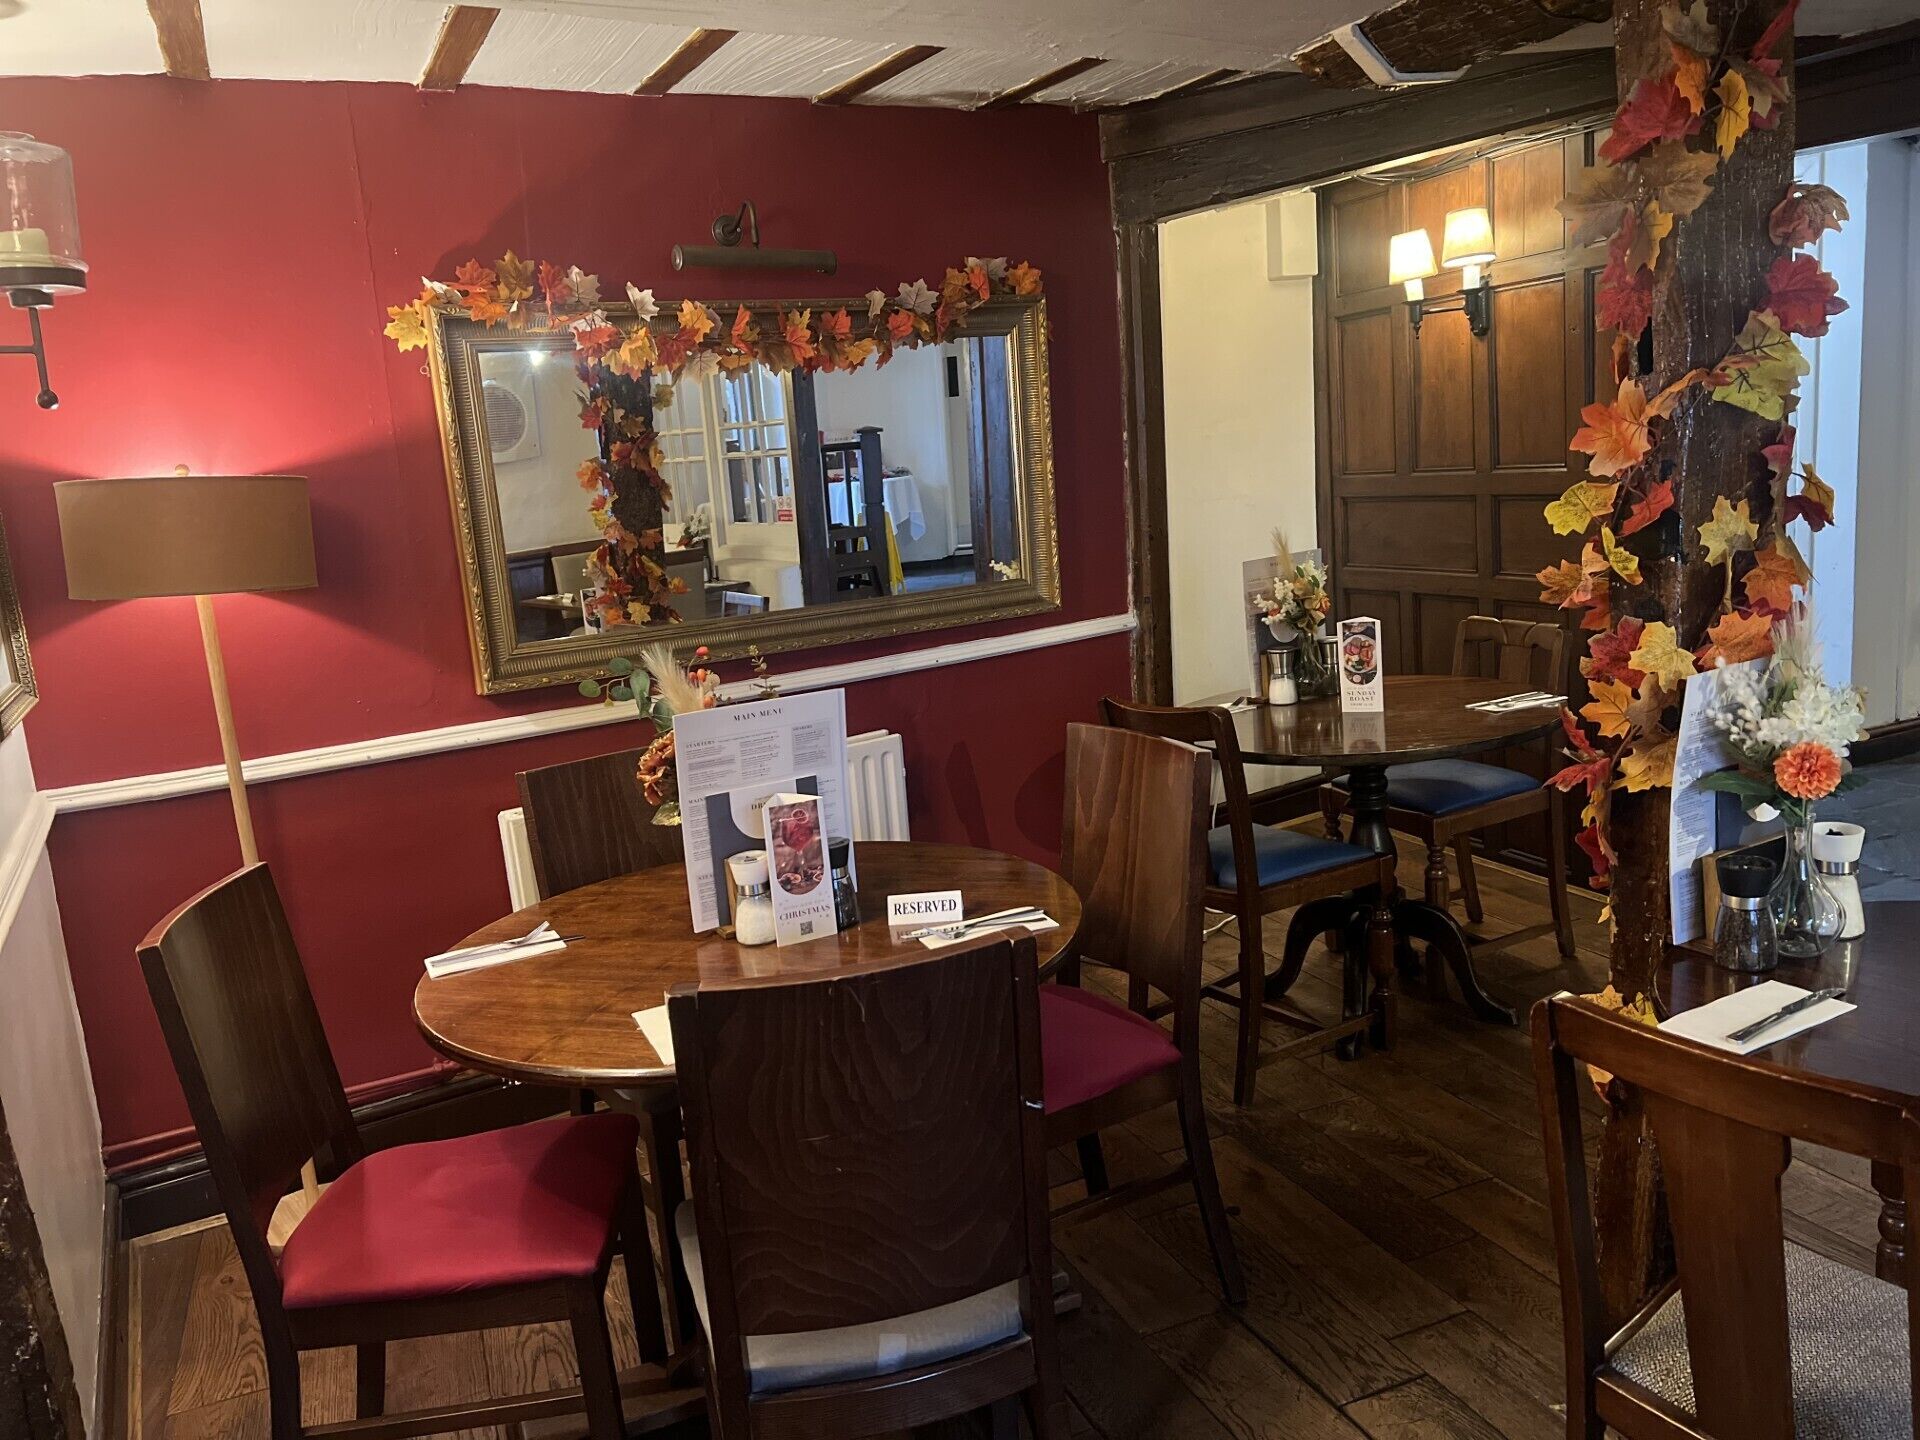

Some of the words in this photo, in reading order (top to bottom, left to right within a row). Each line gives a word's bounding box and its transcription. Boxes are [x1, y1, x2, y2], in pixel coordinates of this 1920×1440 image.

[733, 712, 757, 722] MAIN
[759, 707, 784, 717] MENU
[685, 740, 715, 749] STARTERS
[779, 903, 832, 921] CHRISTMAS
[893, 898, 957, 916] RESERVED
